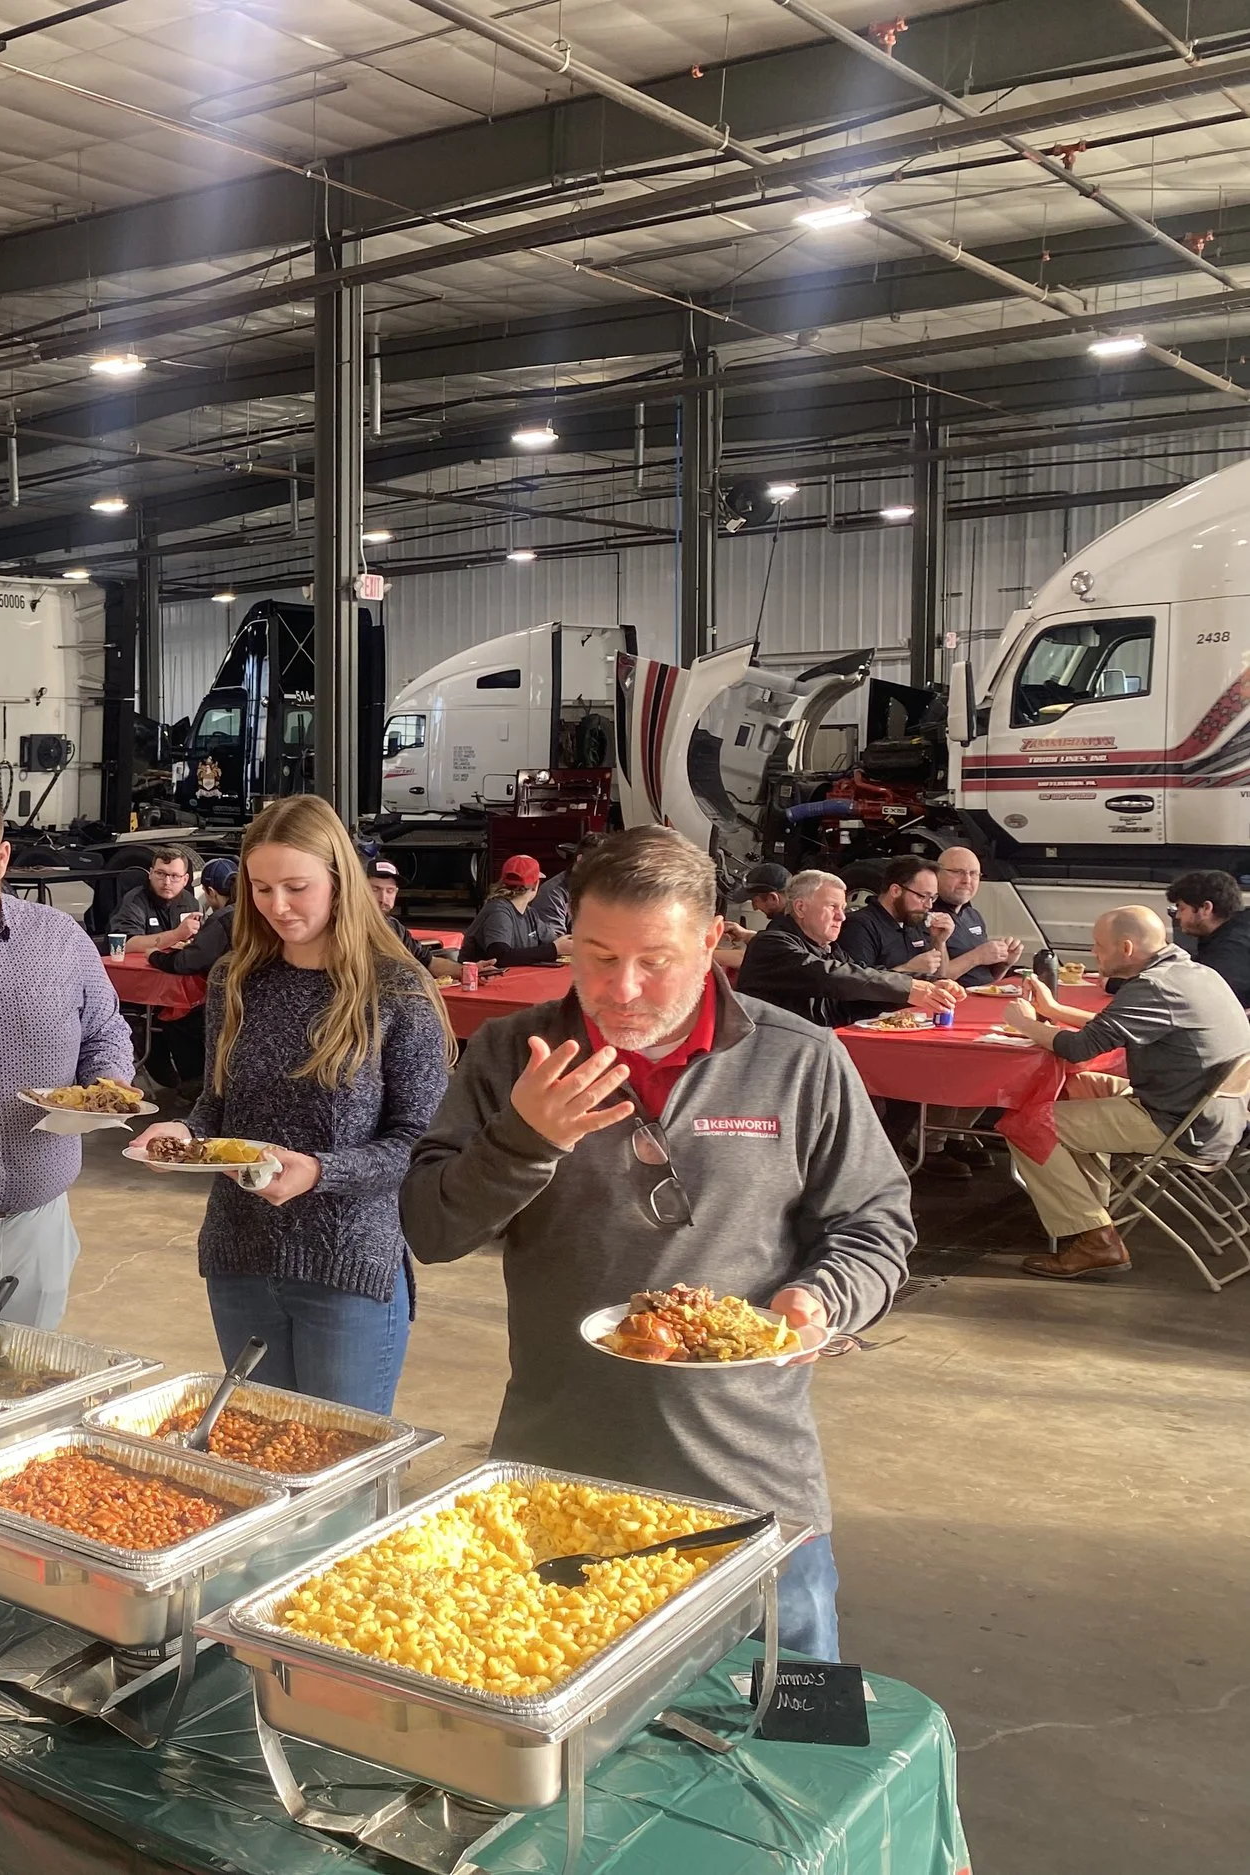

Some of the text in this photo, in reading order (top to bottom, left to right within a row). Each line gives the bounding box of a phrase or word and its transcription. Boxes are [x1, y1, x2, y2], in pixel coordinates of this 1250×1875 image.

[365, 576, 380, 598] EXIT
[1196, 631, 1230, 645] 2438
[295, 690, 311, 702] 514
[710, 1119, 777, 1131] KENWORTH
[775, 1672, 826, 1686] omma's
[776, 1691, 815, 1711] Mac
